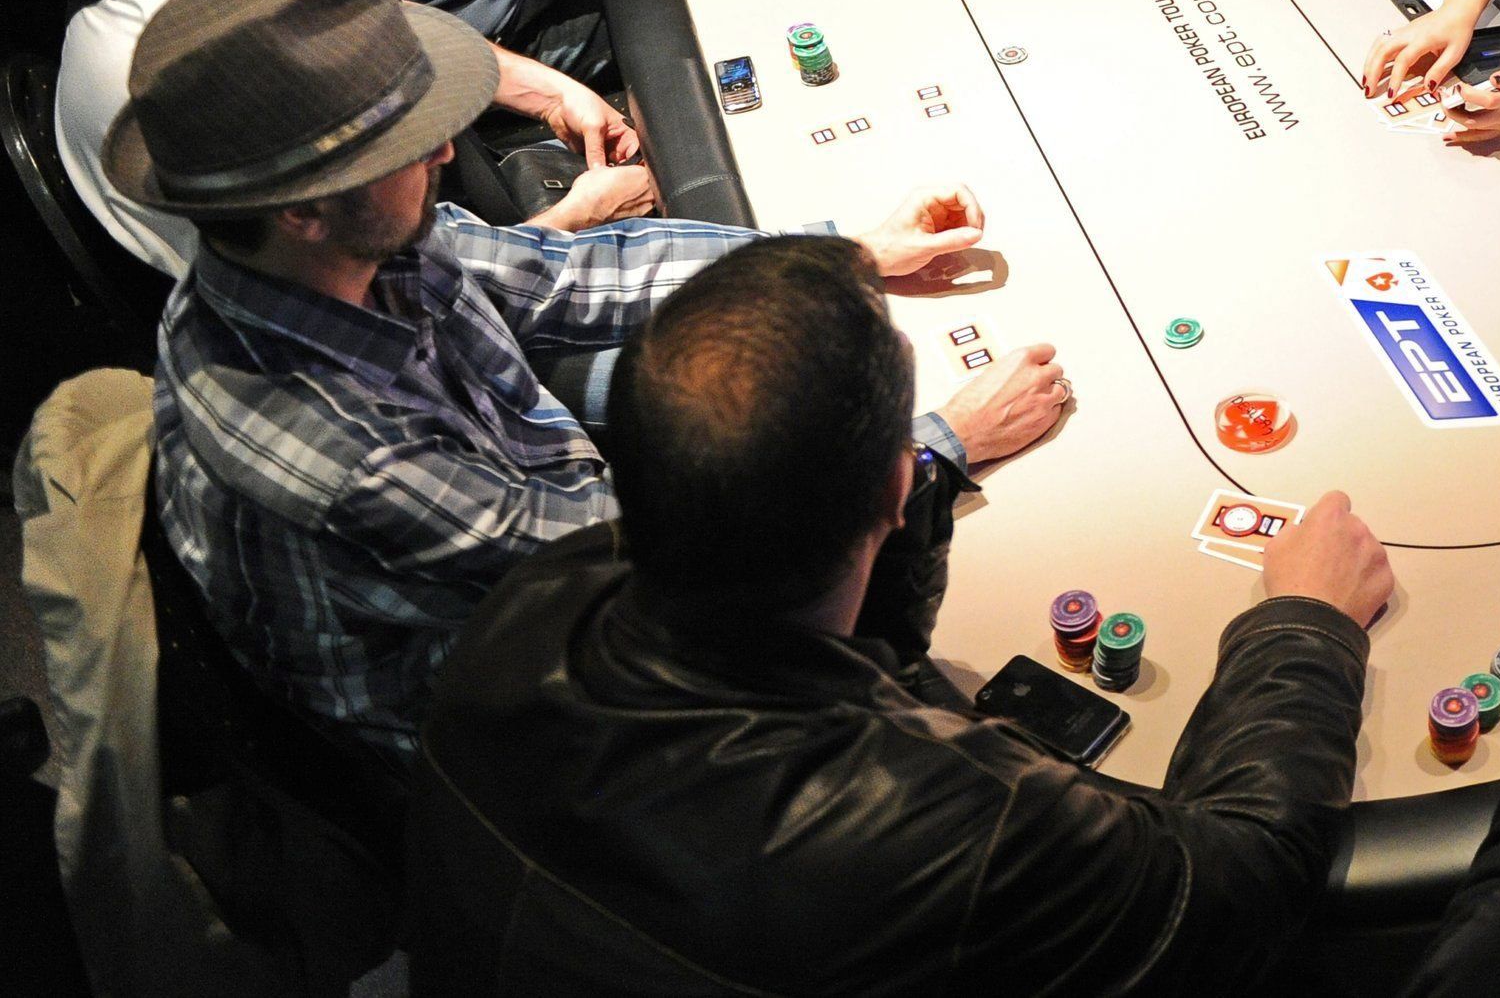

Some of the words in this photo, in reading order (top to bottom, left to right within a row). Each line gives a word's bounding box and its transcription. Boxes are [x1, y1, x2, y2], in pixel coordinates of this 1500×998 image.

[1173, 23, 1215, 65] POKER
[1203, 67, 1267, 140] EUROPEAN
[1399, 261, 1431, 292] TOUR
[1425, 296, 1466, 336] POKER
[1374, 310, 1473, 404] EPT
